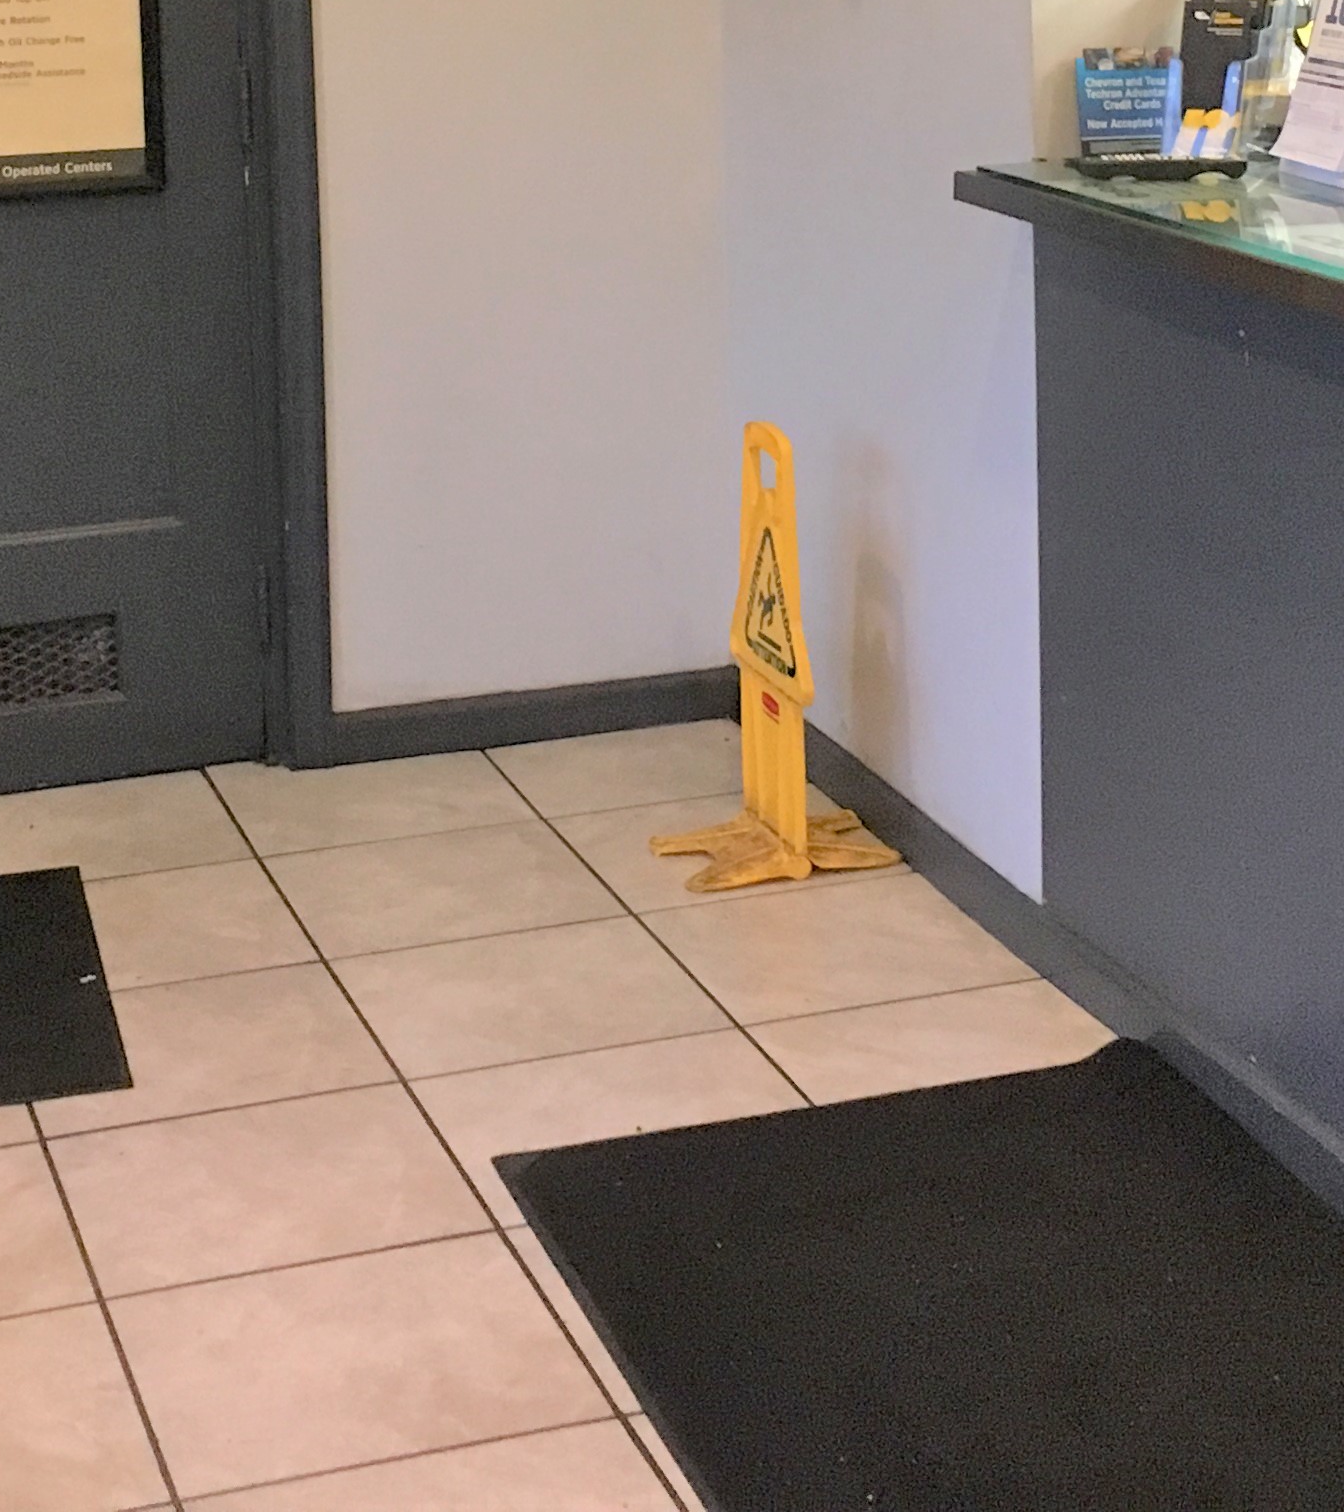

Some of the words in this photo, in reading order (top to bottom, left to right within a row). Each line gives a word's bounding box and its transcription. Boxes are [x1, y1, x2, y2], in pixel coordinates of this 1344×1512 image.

[1125, 76, 1143, 87] and
[1103, 100, 1132, 111] Credit
[1134, 99, 1161, 110] Cards
[2, 163, 60, 180] Operated
[65, 160, 113, 175] Centers
